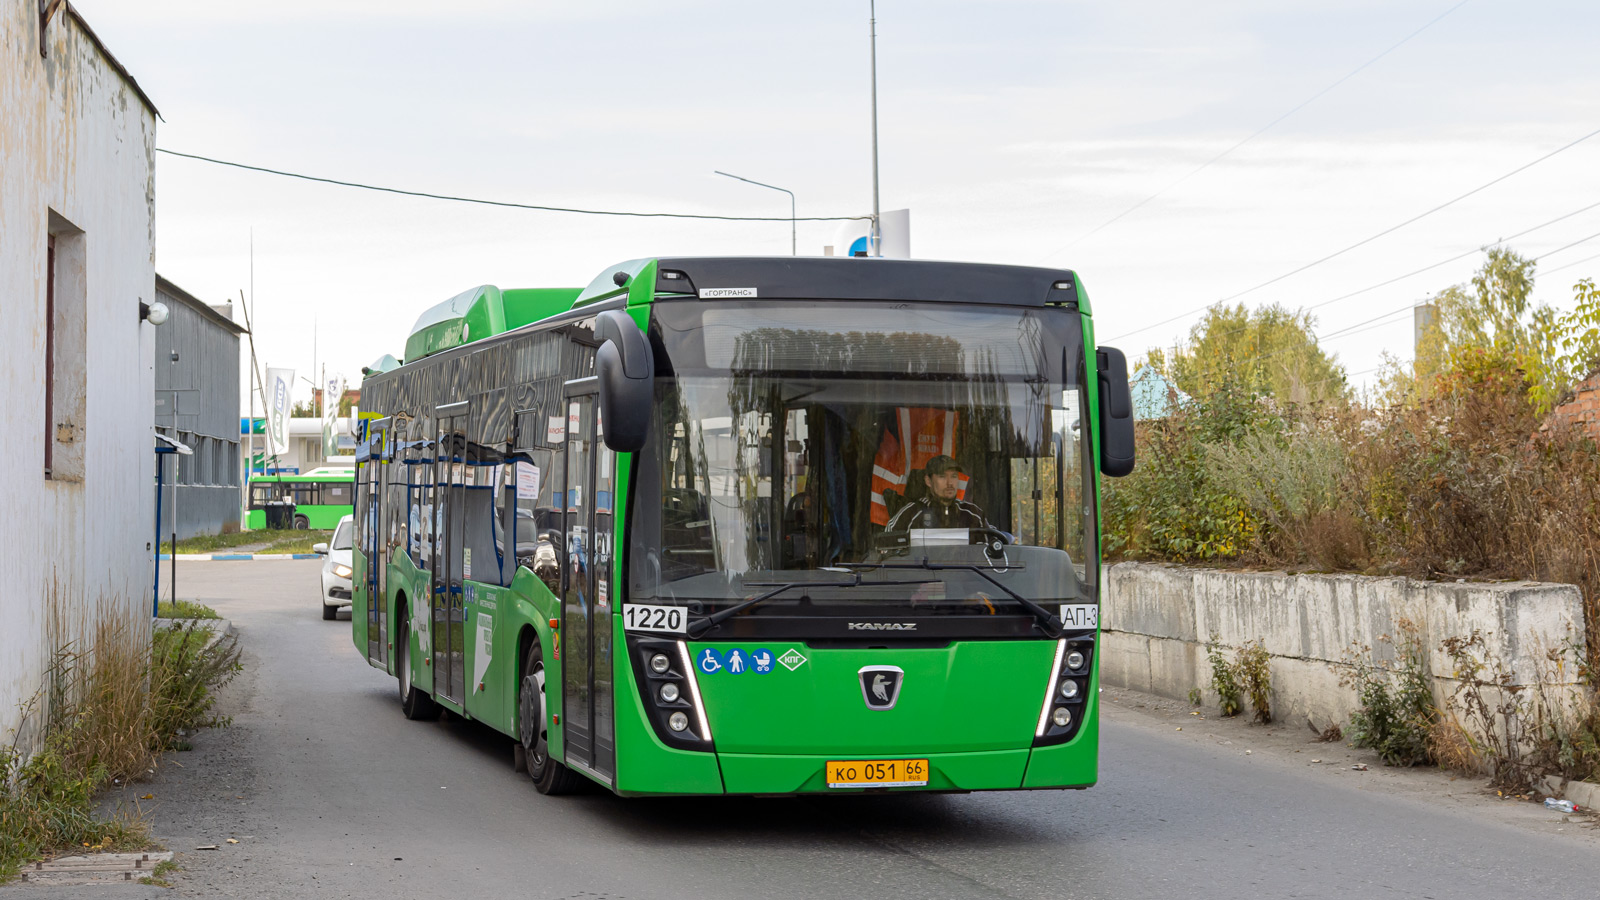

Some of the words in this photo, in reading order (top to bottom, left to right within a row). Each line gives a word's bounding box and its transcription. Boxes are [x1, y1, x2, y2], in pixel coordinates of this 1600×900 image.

[627, 607, 681, 630] 1220
[1064, 608, 1096, 626] АП-3
[848, 622, 917, 631] KAMAZ
[784, 655, 801, 664] КПГ
[864, 763, 896, 780] 051
[906, 761, 922, 774] 66
